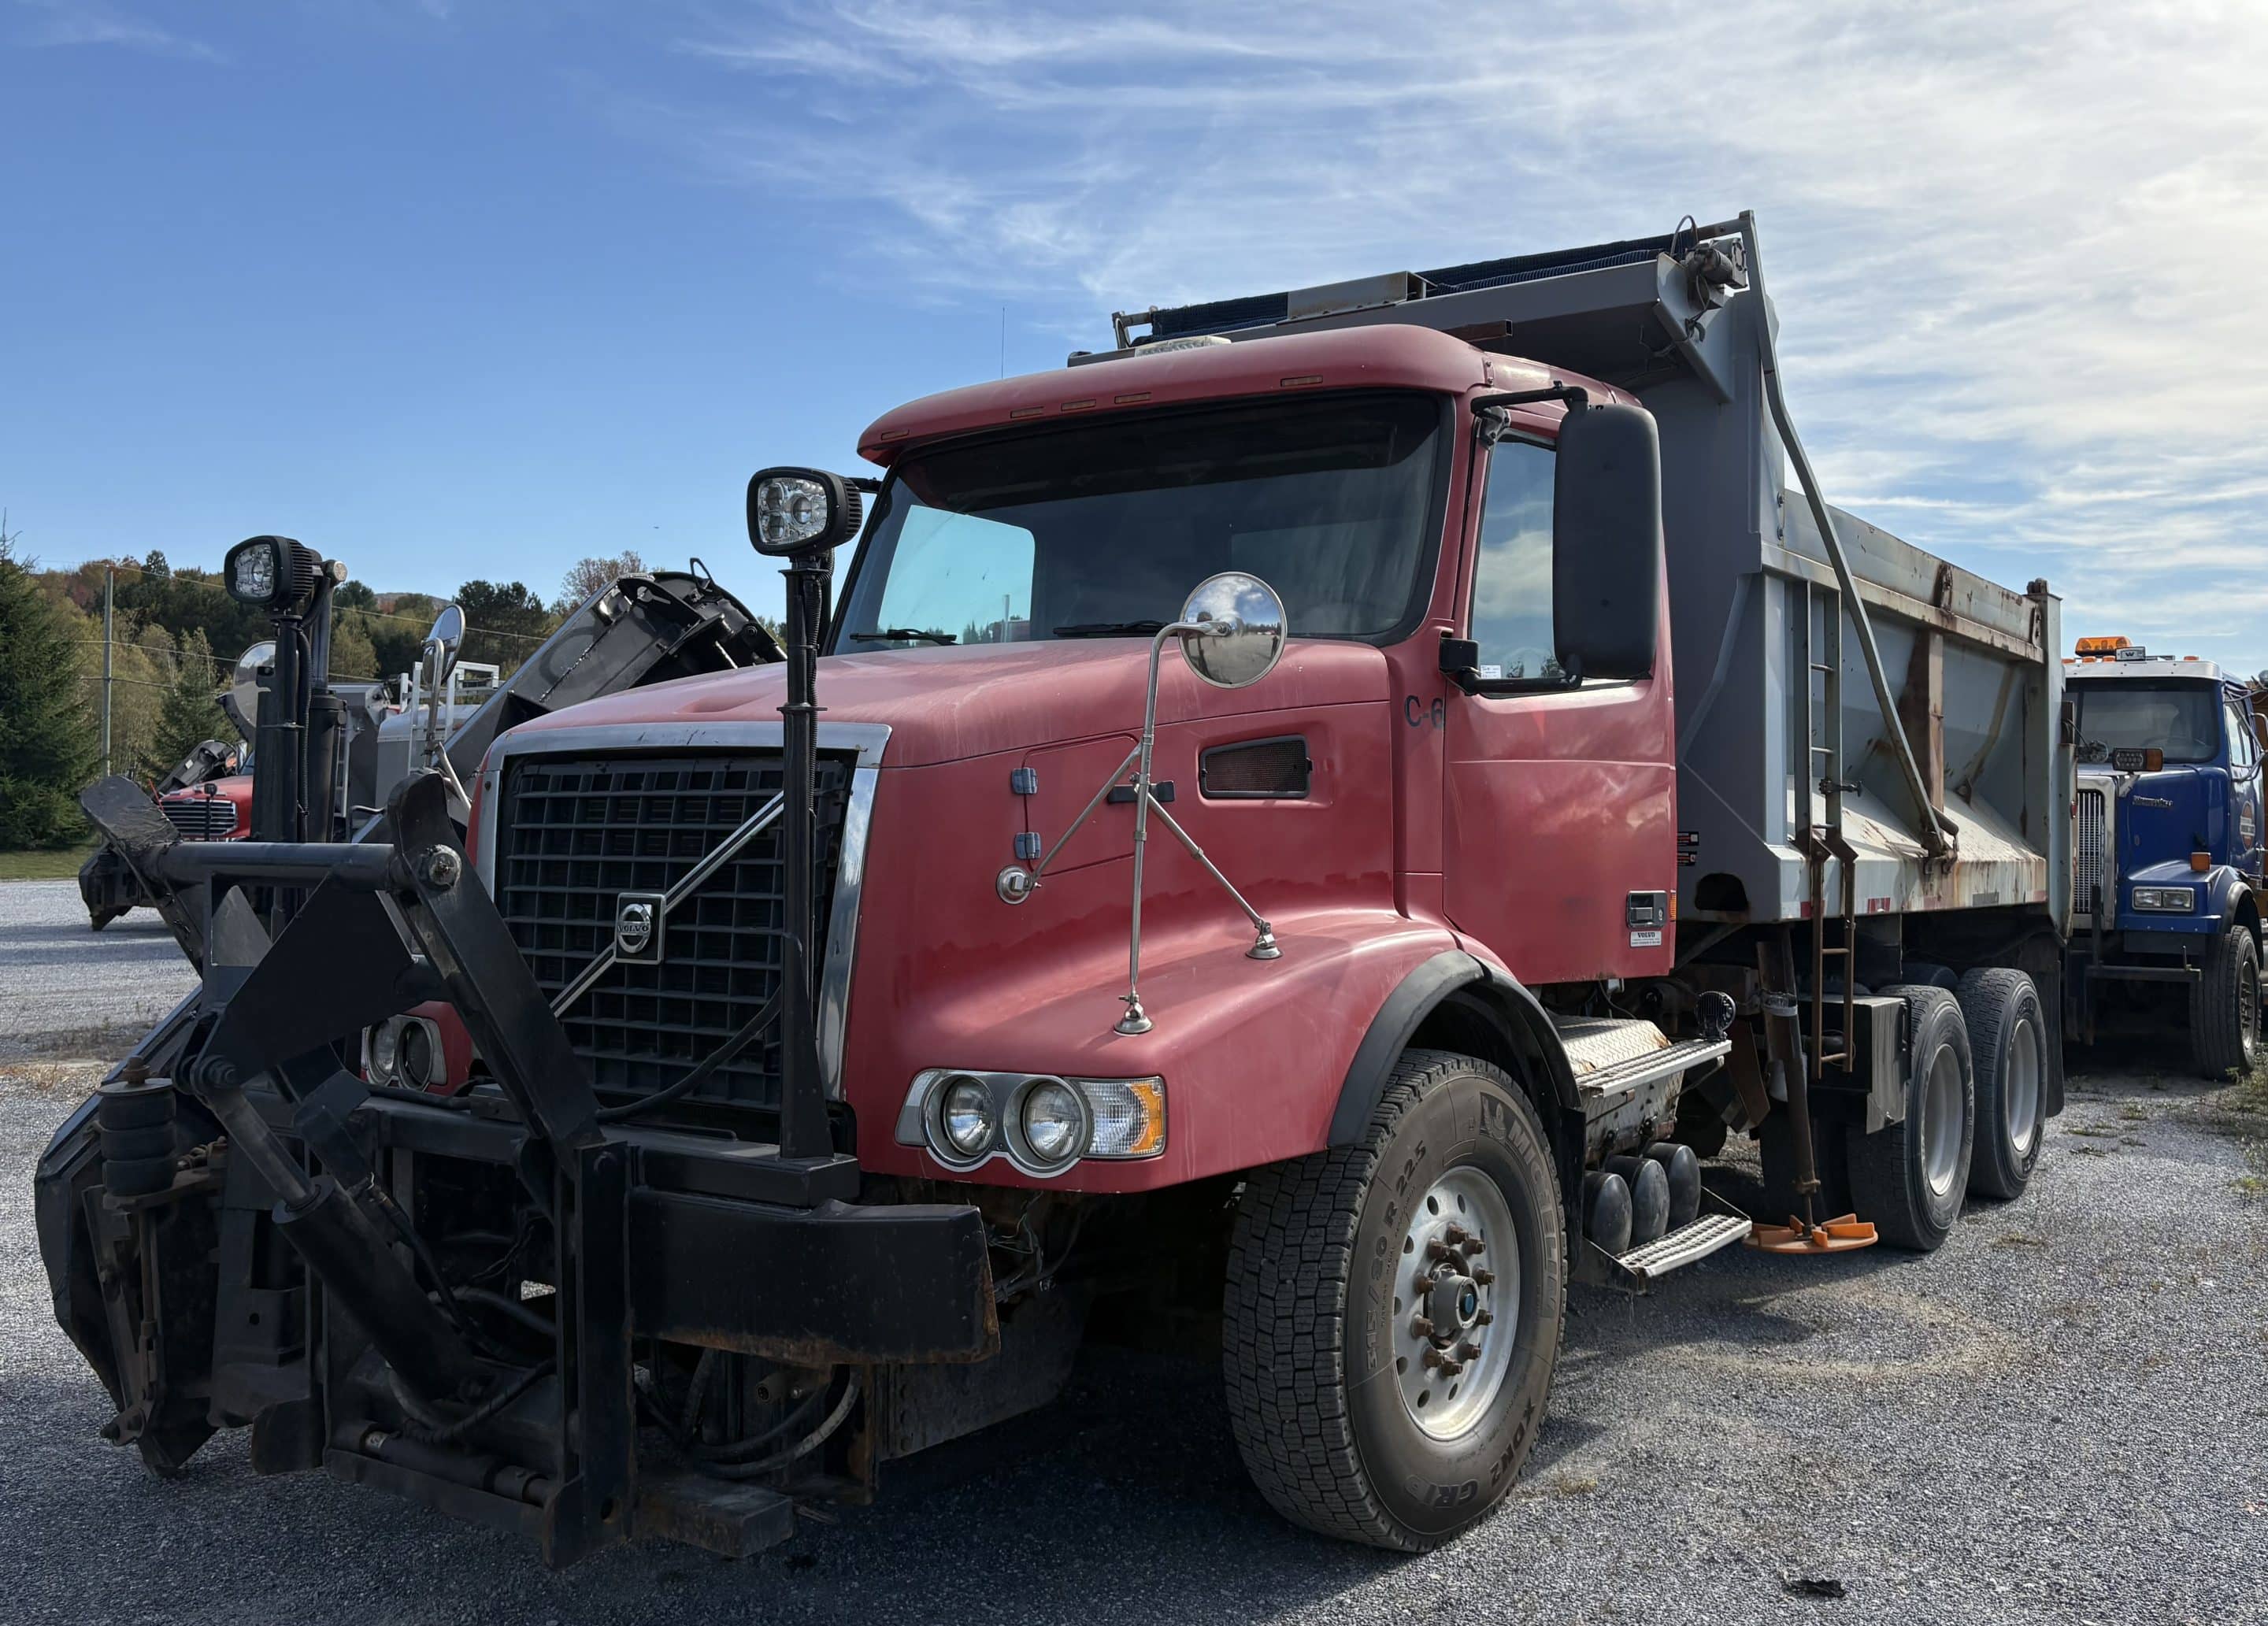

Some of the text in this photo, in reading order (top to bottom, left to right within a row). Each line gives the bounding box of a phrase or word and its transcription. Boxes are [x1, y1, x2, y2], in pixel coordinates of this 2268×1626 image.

[617, 924, 650, 933] VOLVO
[1384, 1200, 1399, 1229] R
[1395, 1139, 1426, 1197] 22.5
[1507, 1118, 1558, 1317] MICHELIN
